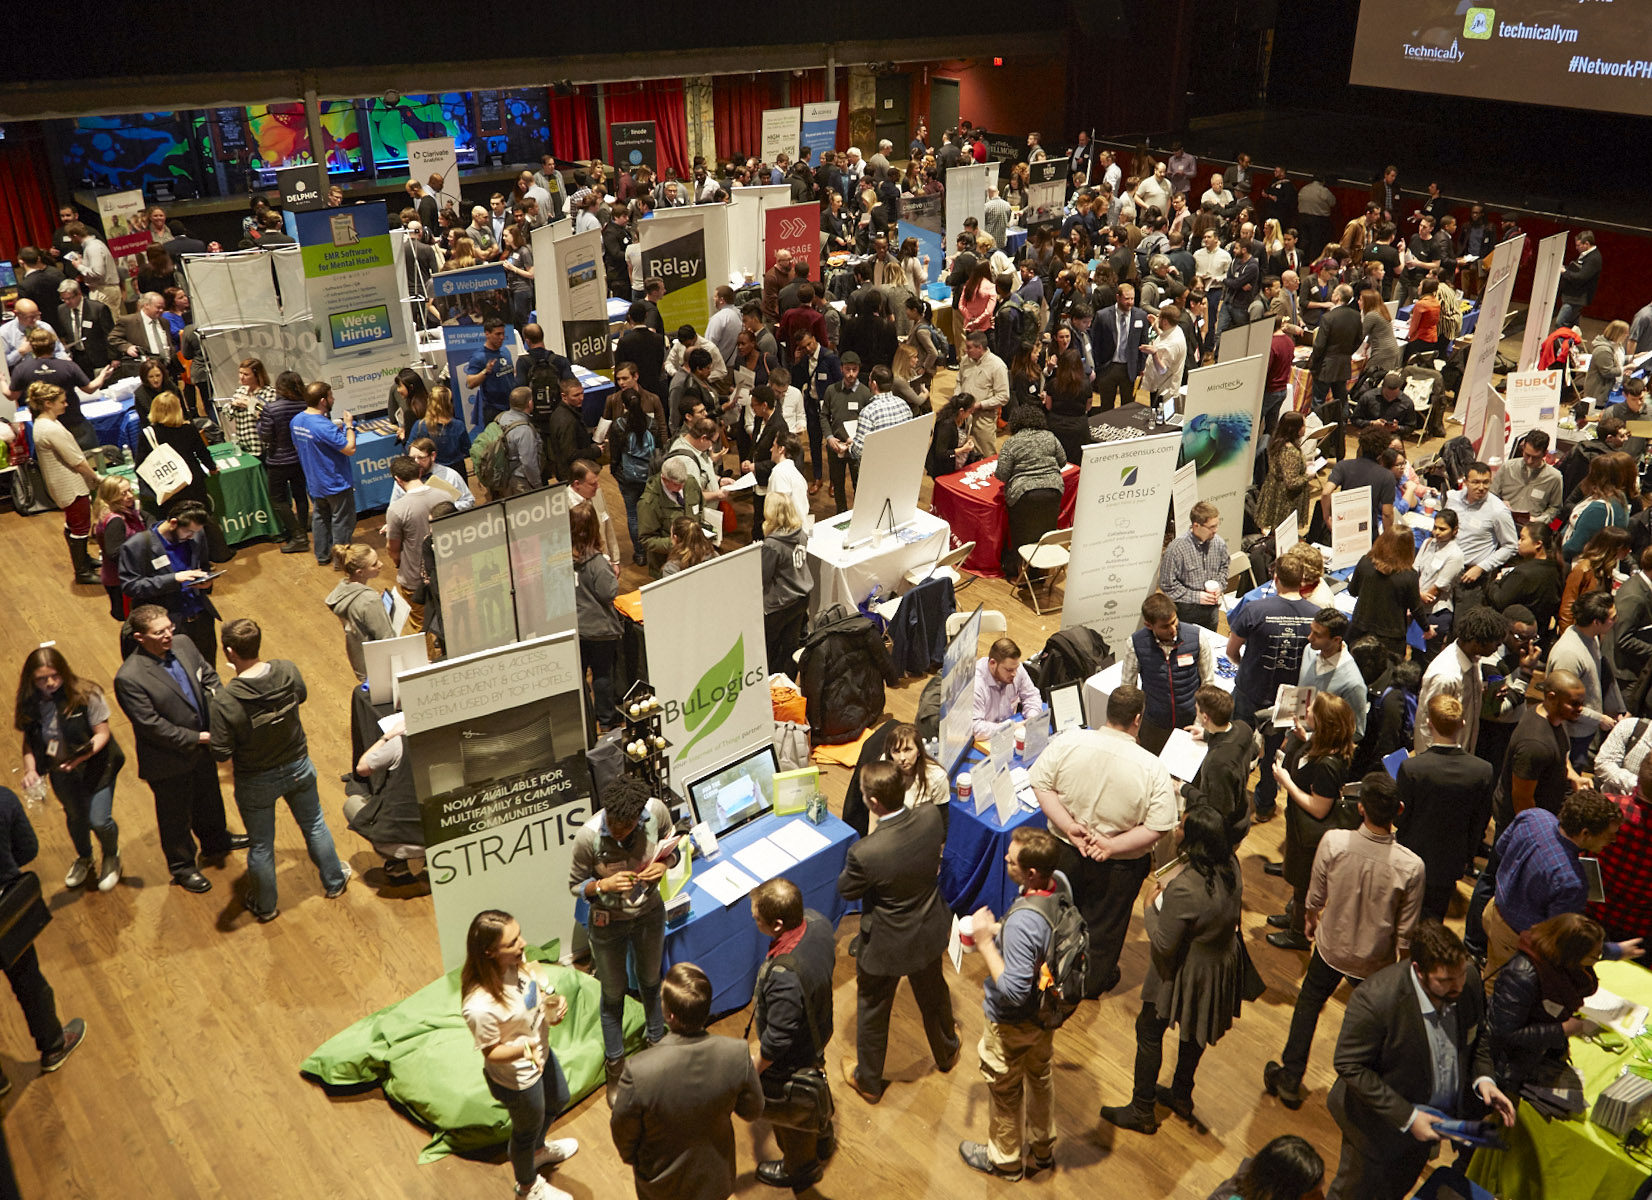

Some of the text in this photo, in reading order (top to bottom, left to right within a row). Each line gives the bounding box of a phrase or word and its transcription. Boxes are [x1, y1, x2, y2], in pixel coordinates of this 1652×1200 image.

[1499, 21, 1578, 43] technicallym
[1403, 37, 1464, 62] Technically
[422, 150, 449, 158] Clarivate
[990, 146, 1019, 159] ILLMORE
[286, 191, 318, 203] DELPHIC
[324, 248, 372, 261] EMR Software
[774, 244, 812, 257] SAGE
[318, 255, 380, 272] for Mental Health
[456, 278, 498, 290] Webjunto
[342, 314, 377, 328] We're
[340, 326, 386, 342] Hiring.
[346, 367, 402, 385] TherapyNote
[1206, 379, 1243, 392] Mindteck
[1090, 445, 1174, 464] careers.ascensus.com
[153, 460, 178, 480] ARD
[356, 454, 398, 475] Ther
[1098, 487, 1156, 504] ascensus
[219, 509, 268, 533] hire
[428, 650, 548, 688] THE ENERGY & ACCESS
[416, 661, 564, 706] MANAGEMENT & CONTROL
[411, 672, 572, 723] SYSTEM USED BY TOP HOTELS
[664, 666, 764, 724] BuLogics
[742, 724, 762, 739] partner
[443, 769, 564, 813] NOW AVAILABLE FOR
[440, 780, 572, 828] MULTIFAMILY & CAMPUS
[468, 800, 550, 833] COMMUNITIES
[431, 807, 586, 884] STRATIS
